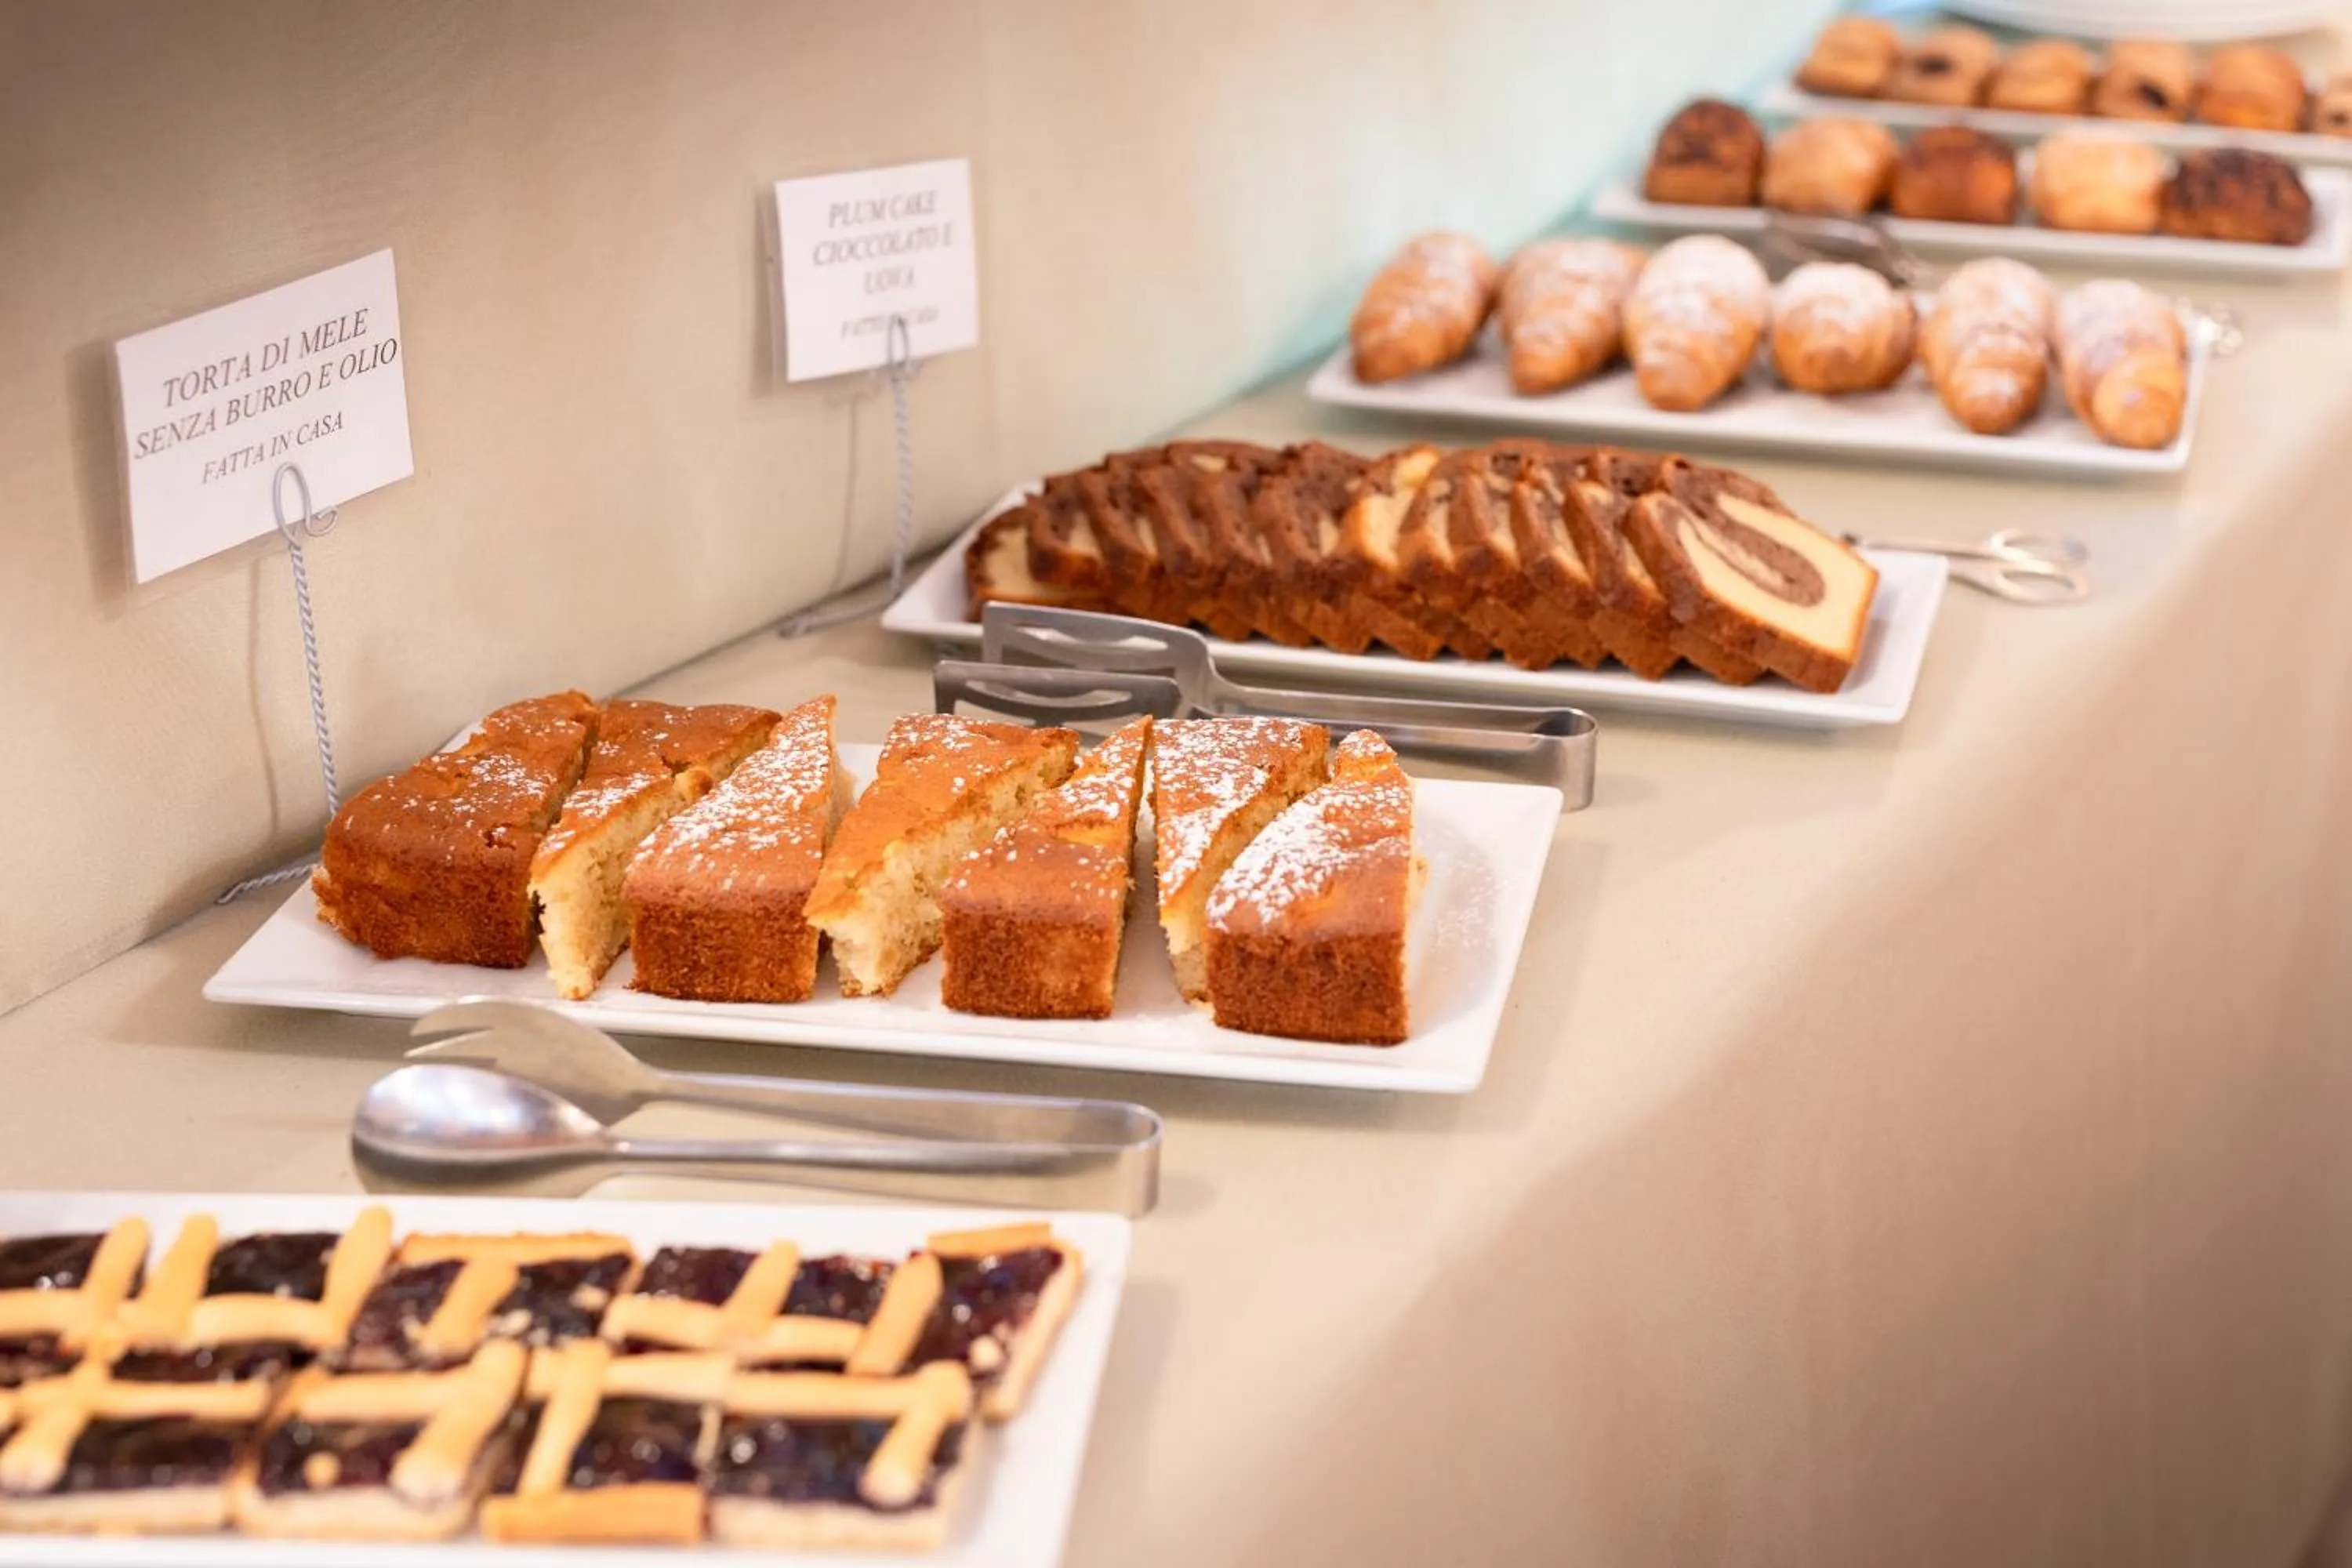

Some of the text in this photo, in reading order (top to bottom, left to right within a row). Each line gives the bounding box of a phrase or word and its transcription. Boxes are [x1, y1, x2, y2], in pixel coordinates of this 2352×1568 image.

[133, 337, 397, 460] SENZA BURRO E OLIO
[163, 308, 368, 407] TORTA DI MELE
[202, 412, 344, 485] FATTA IN CASA
